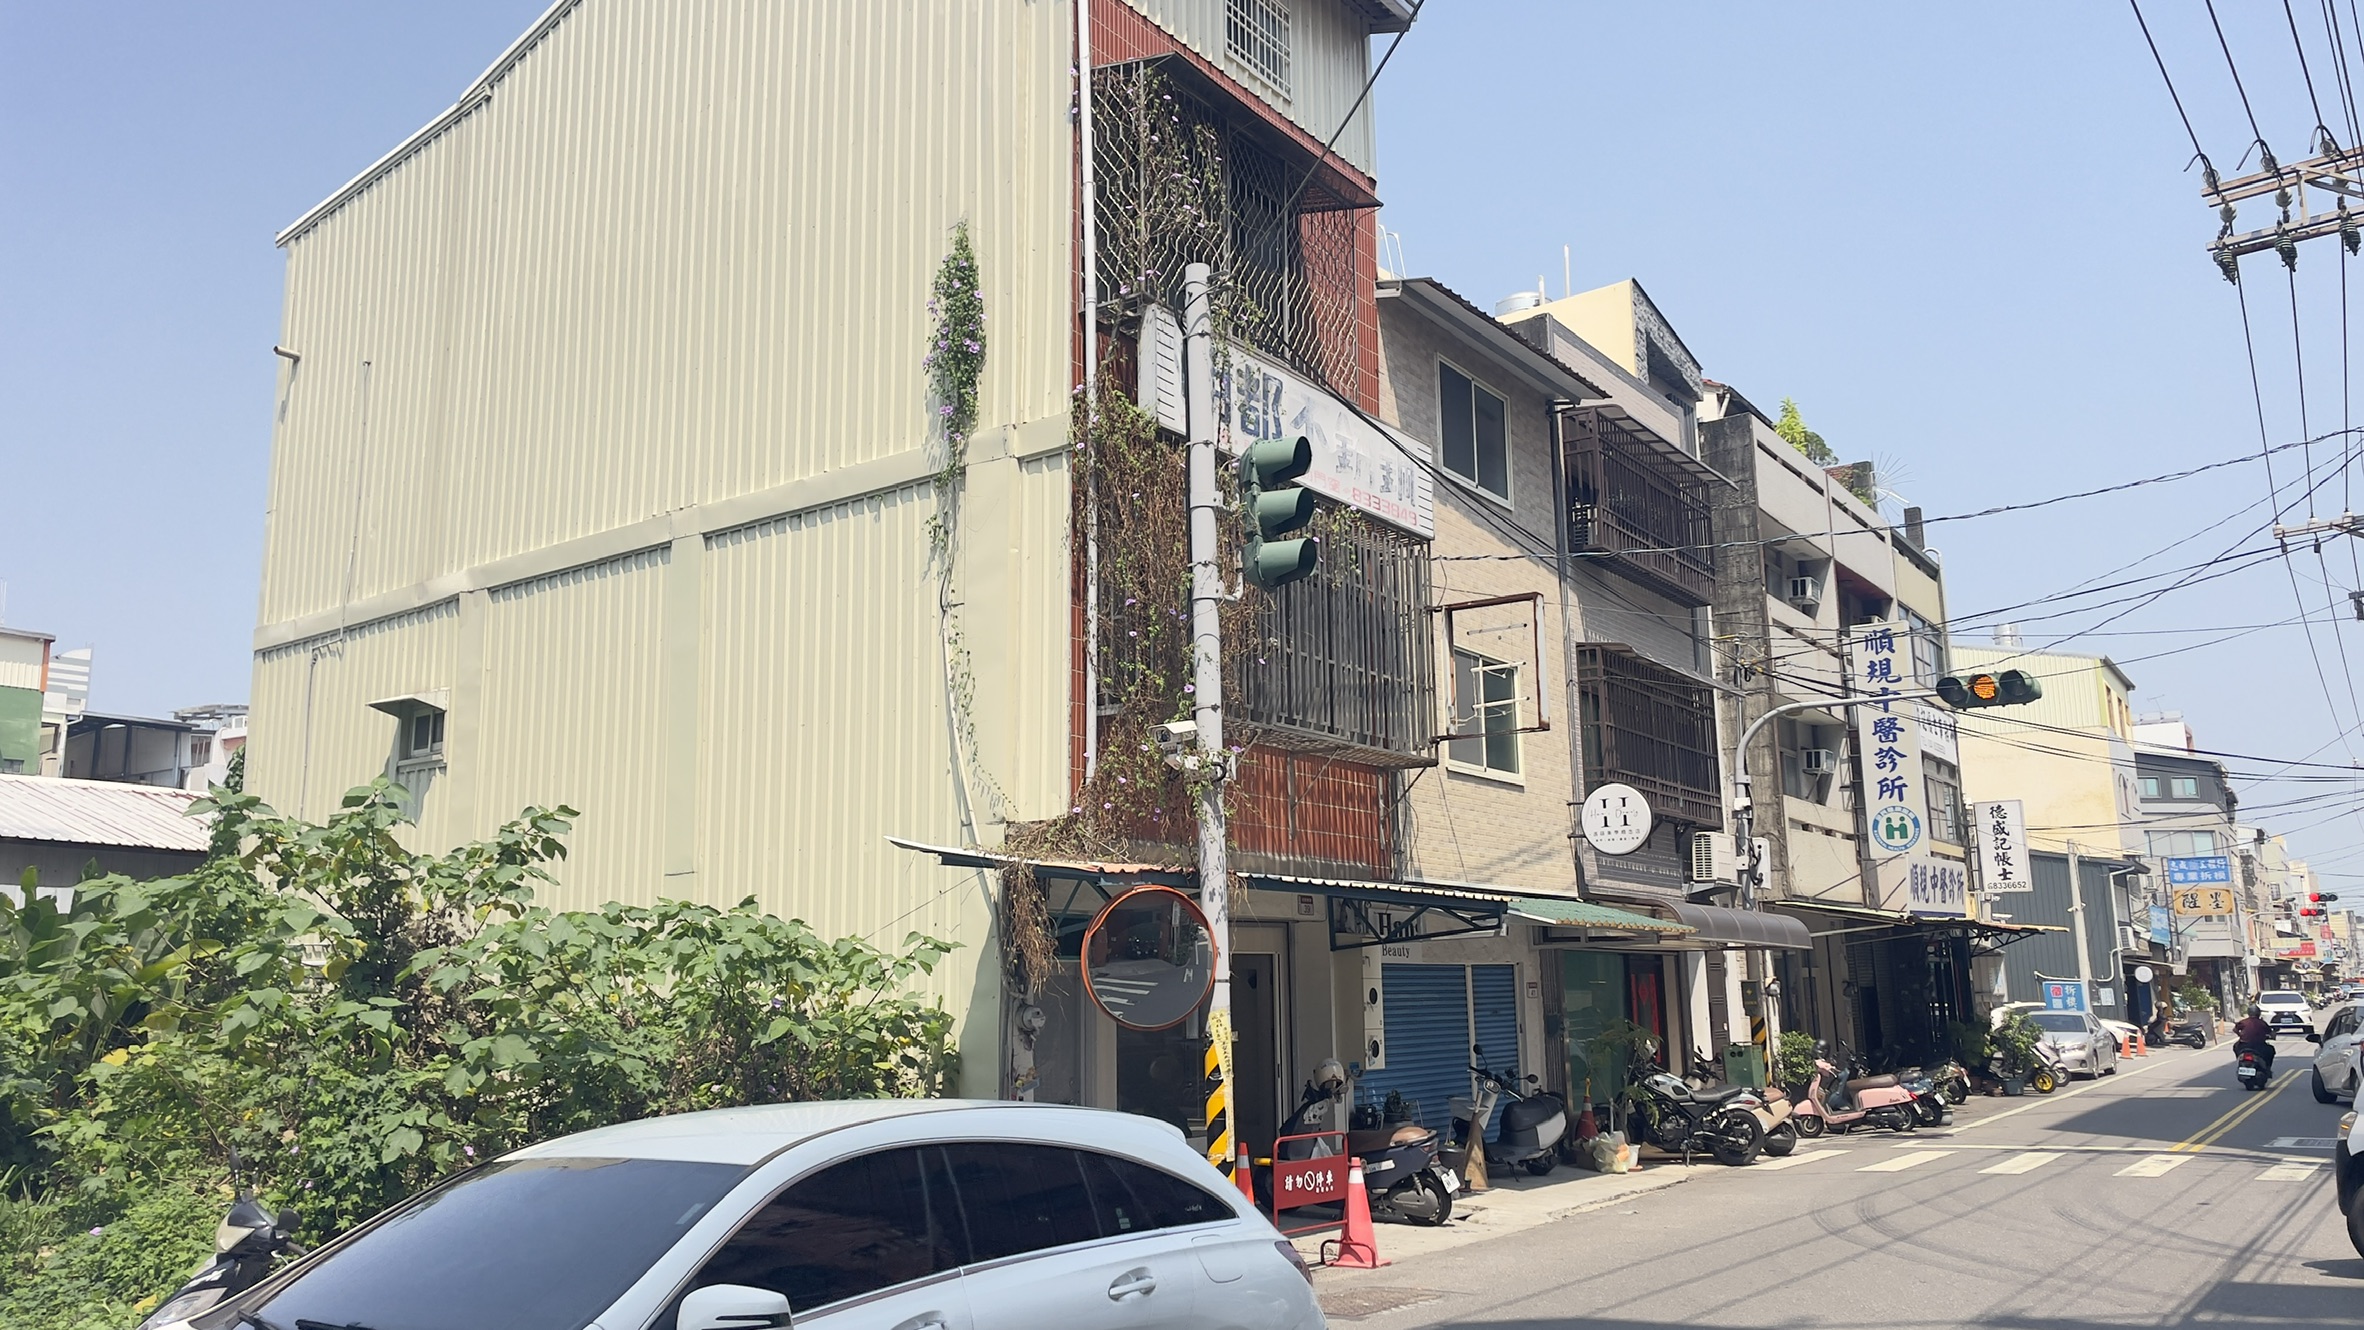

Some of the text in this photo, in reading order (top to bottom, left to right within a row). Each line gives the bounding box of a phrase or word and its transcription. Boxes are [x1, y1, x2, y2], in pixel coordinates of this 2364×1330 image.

[1864, 627, 1908, 803] 順規中醫診所
[1989, 804, 2014, 881] 德成記帳士
[1910, 863, 1965, 905] 順規中醫診所
[1382, 944, 1410, 959] Beauty
